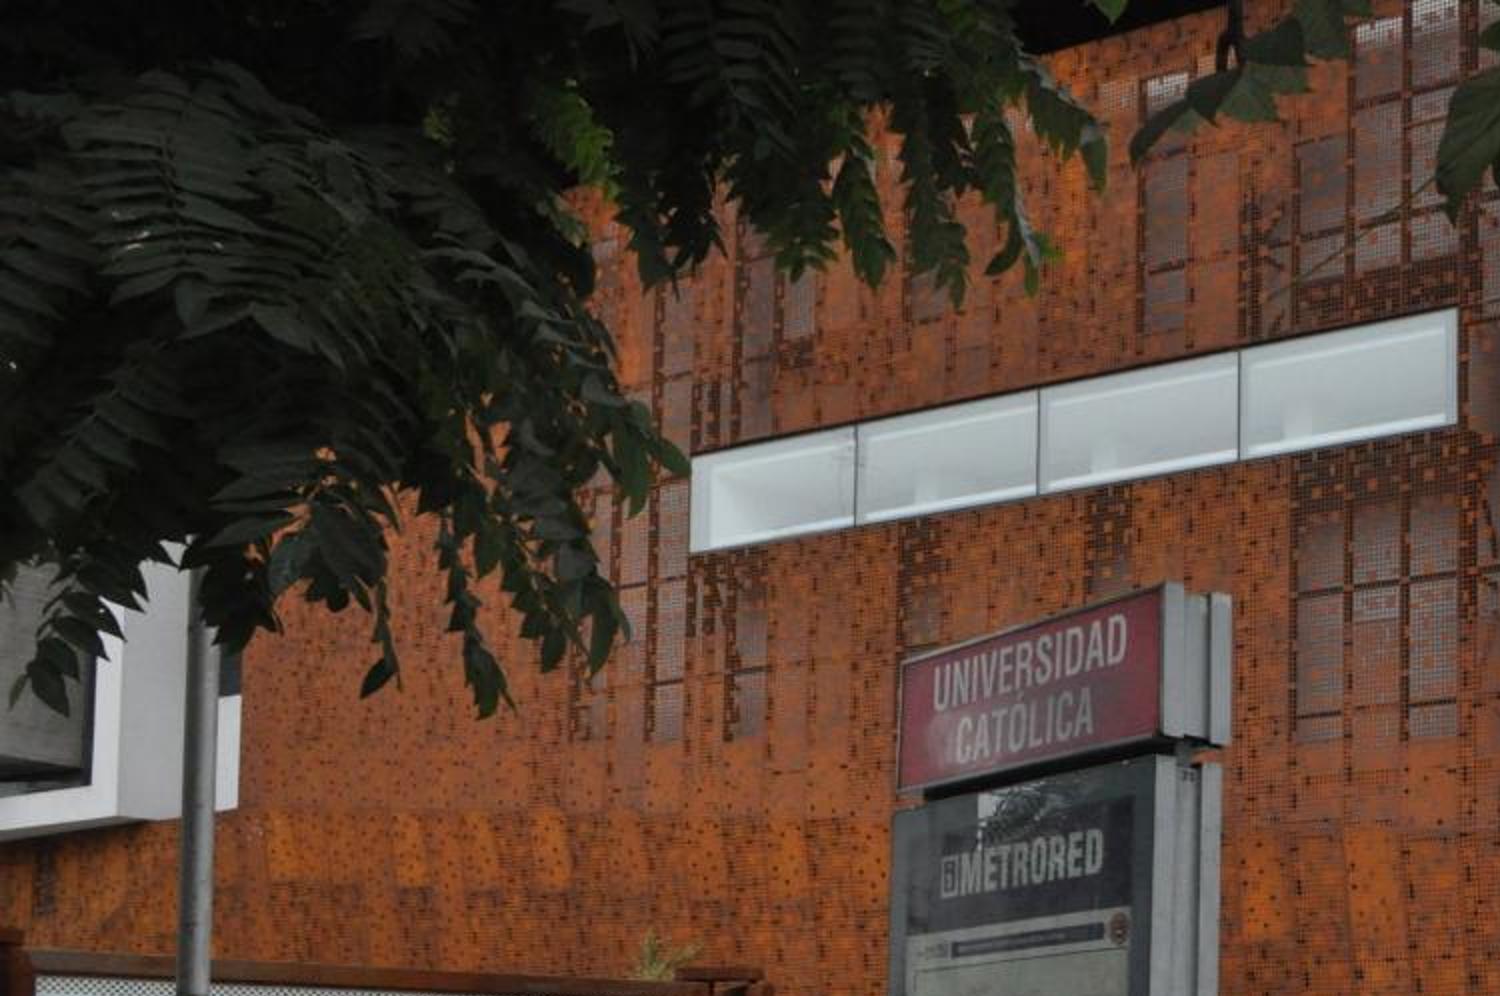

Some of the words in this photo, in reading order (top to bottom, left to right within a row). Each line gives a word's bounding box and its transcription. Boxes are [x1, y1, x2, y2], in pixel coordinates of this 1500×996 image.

[933, 614, 1127, 712] UNIVERSIDAD
[955, 687, 1094, 764] CATÓLICA
[960, 829, 1104, 896] METRORED
